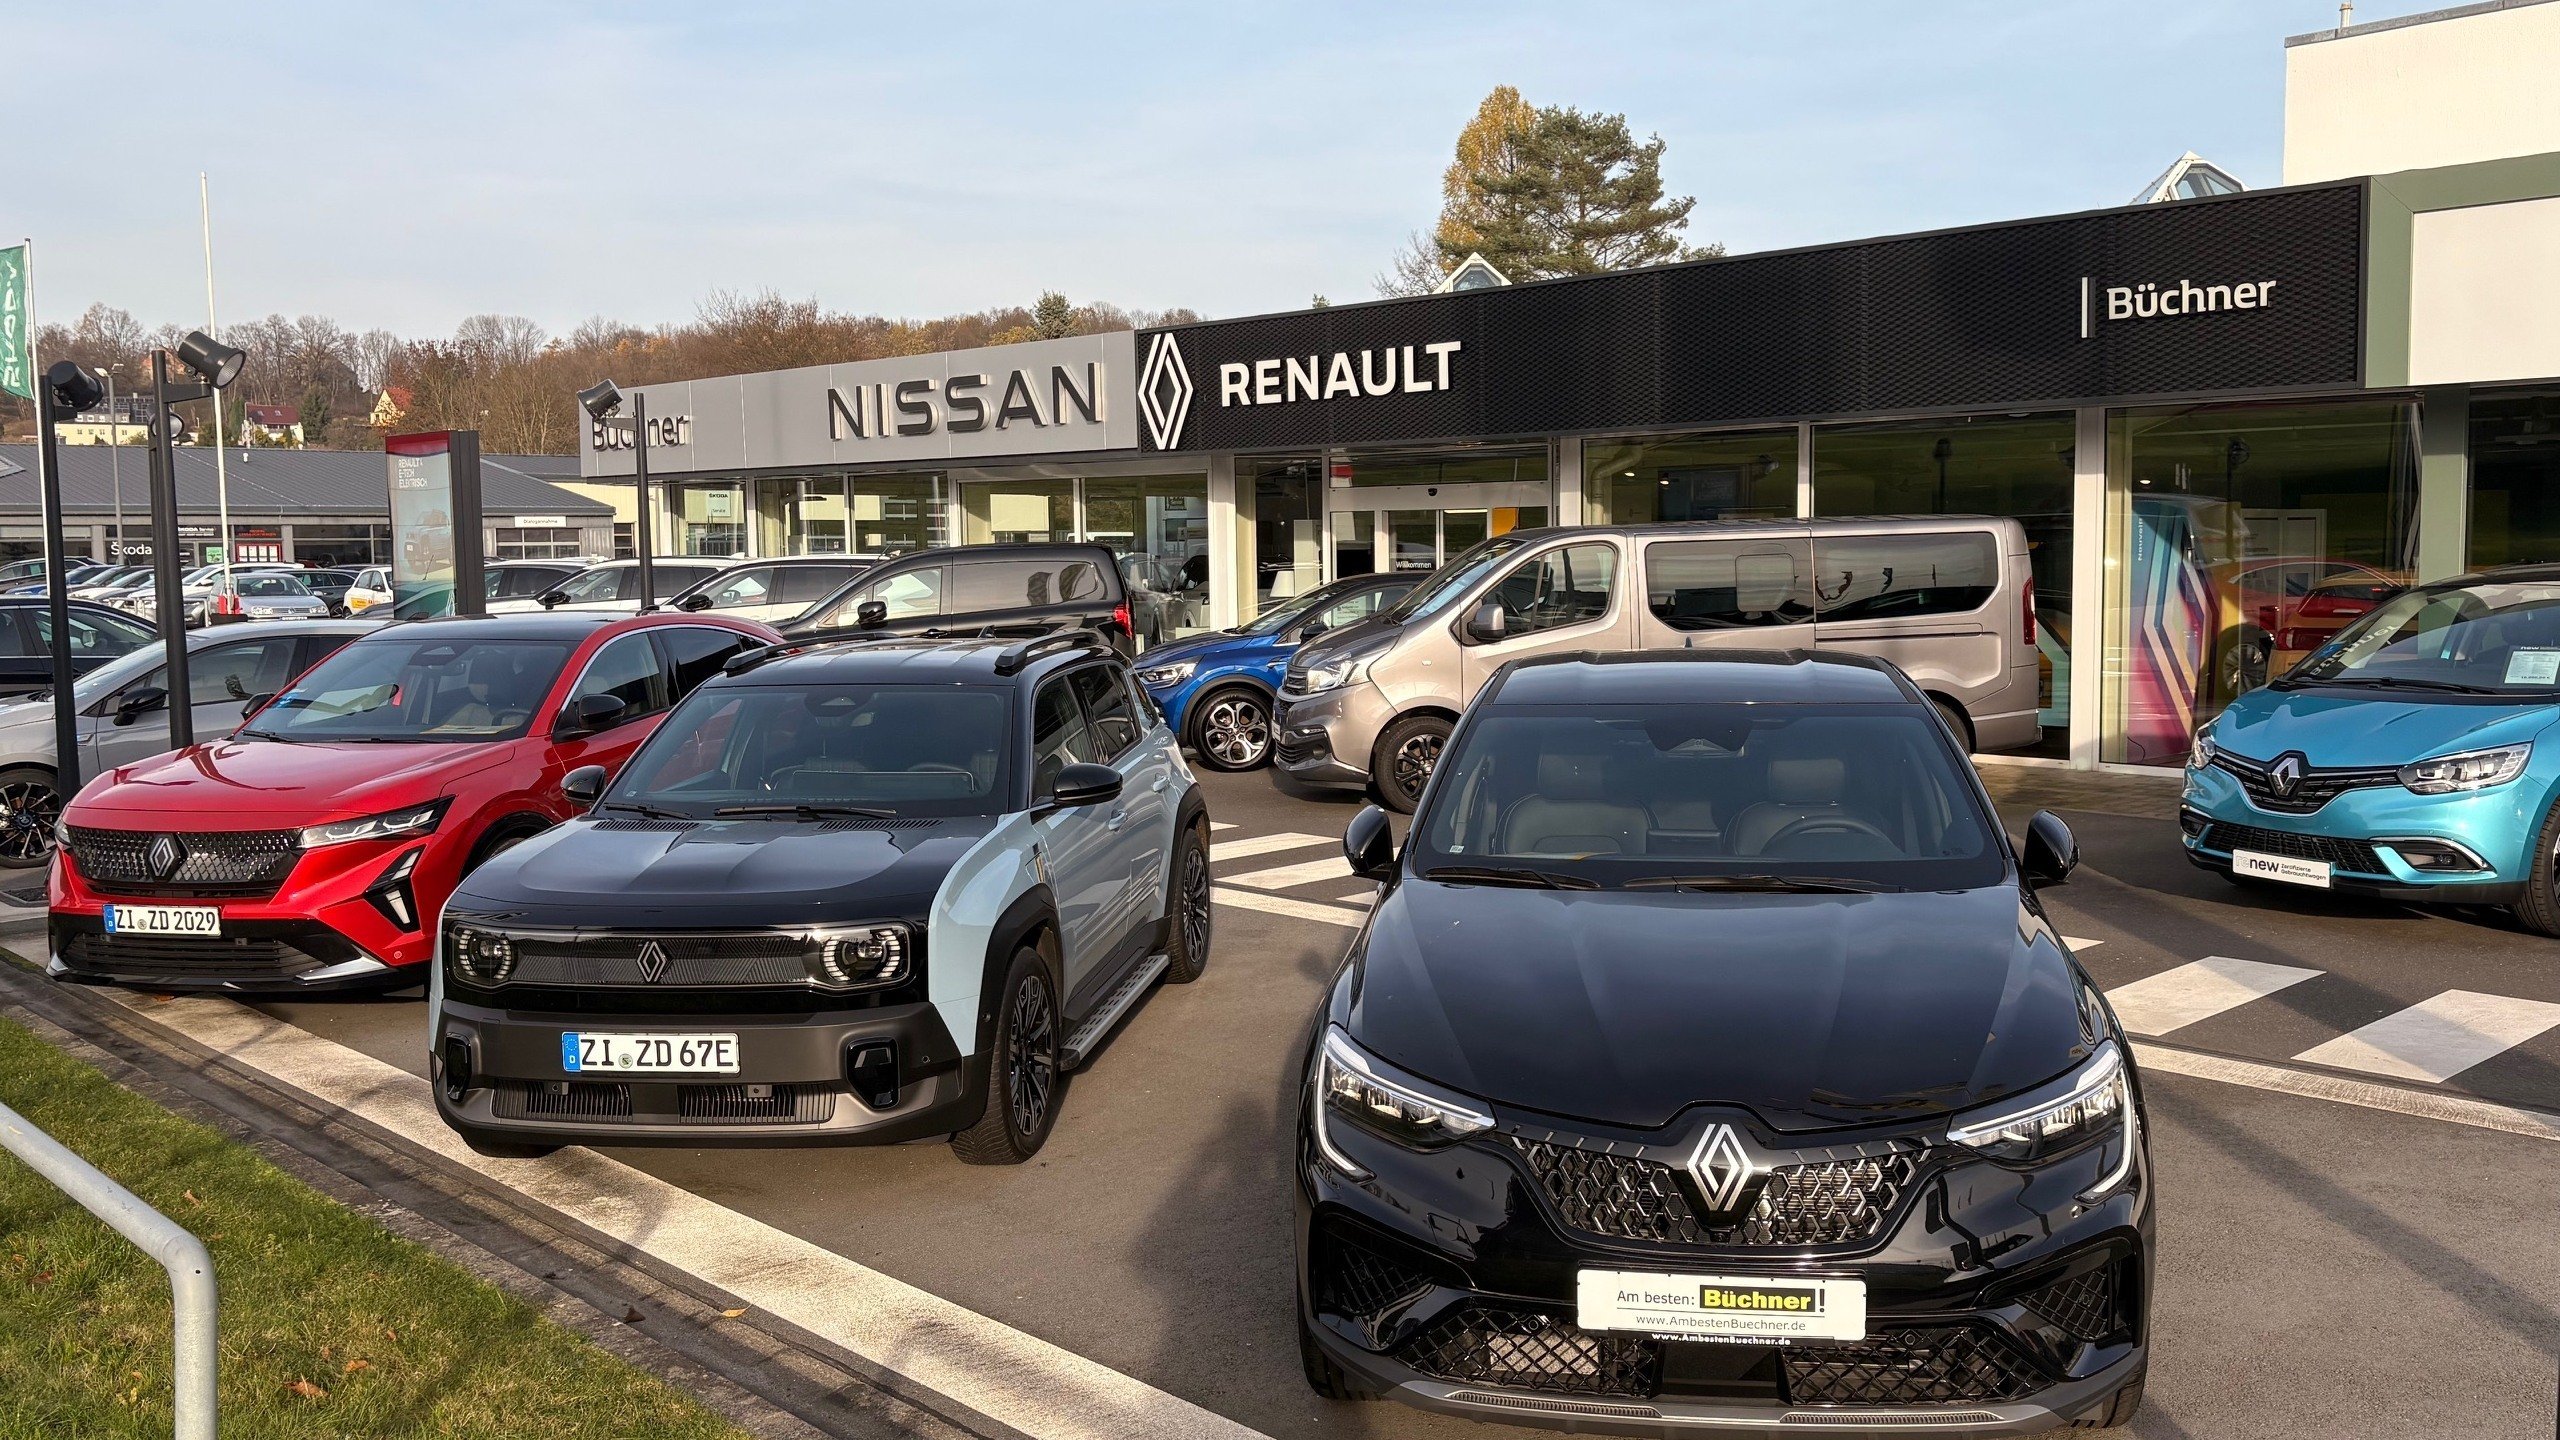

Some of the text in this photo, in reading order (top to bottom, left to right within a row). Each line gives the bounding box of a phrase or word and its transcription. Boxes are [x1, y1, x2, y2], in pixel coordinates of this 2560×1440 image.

[2107, 279, 2277, 320] Büchner
[1220, 341, 1462, 407] RENAULT
[827, 361, 1105, 440] NISSAN
[1395, 561, 1432, 569] Willkommen
[115, 909, 216, 931] ZI ZD 2029
[580, 1039, 734, 1067] ZI ZD 67E
[1617, 1290, 1639, 1303] Am
[1644, 1291, 1696, 1306] besten:
[1635, 1314, 1807, 1332] www.AmbestenBuechner.de
[1650, 1332, 1792, 1347] www.AmbestenBuechner.de
